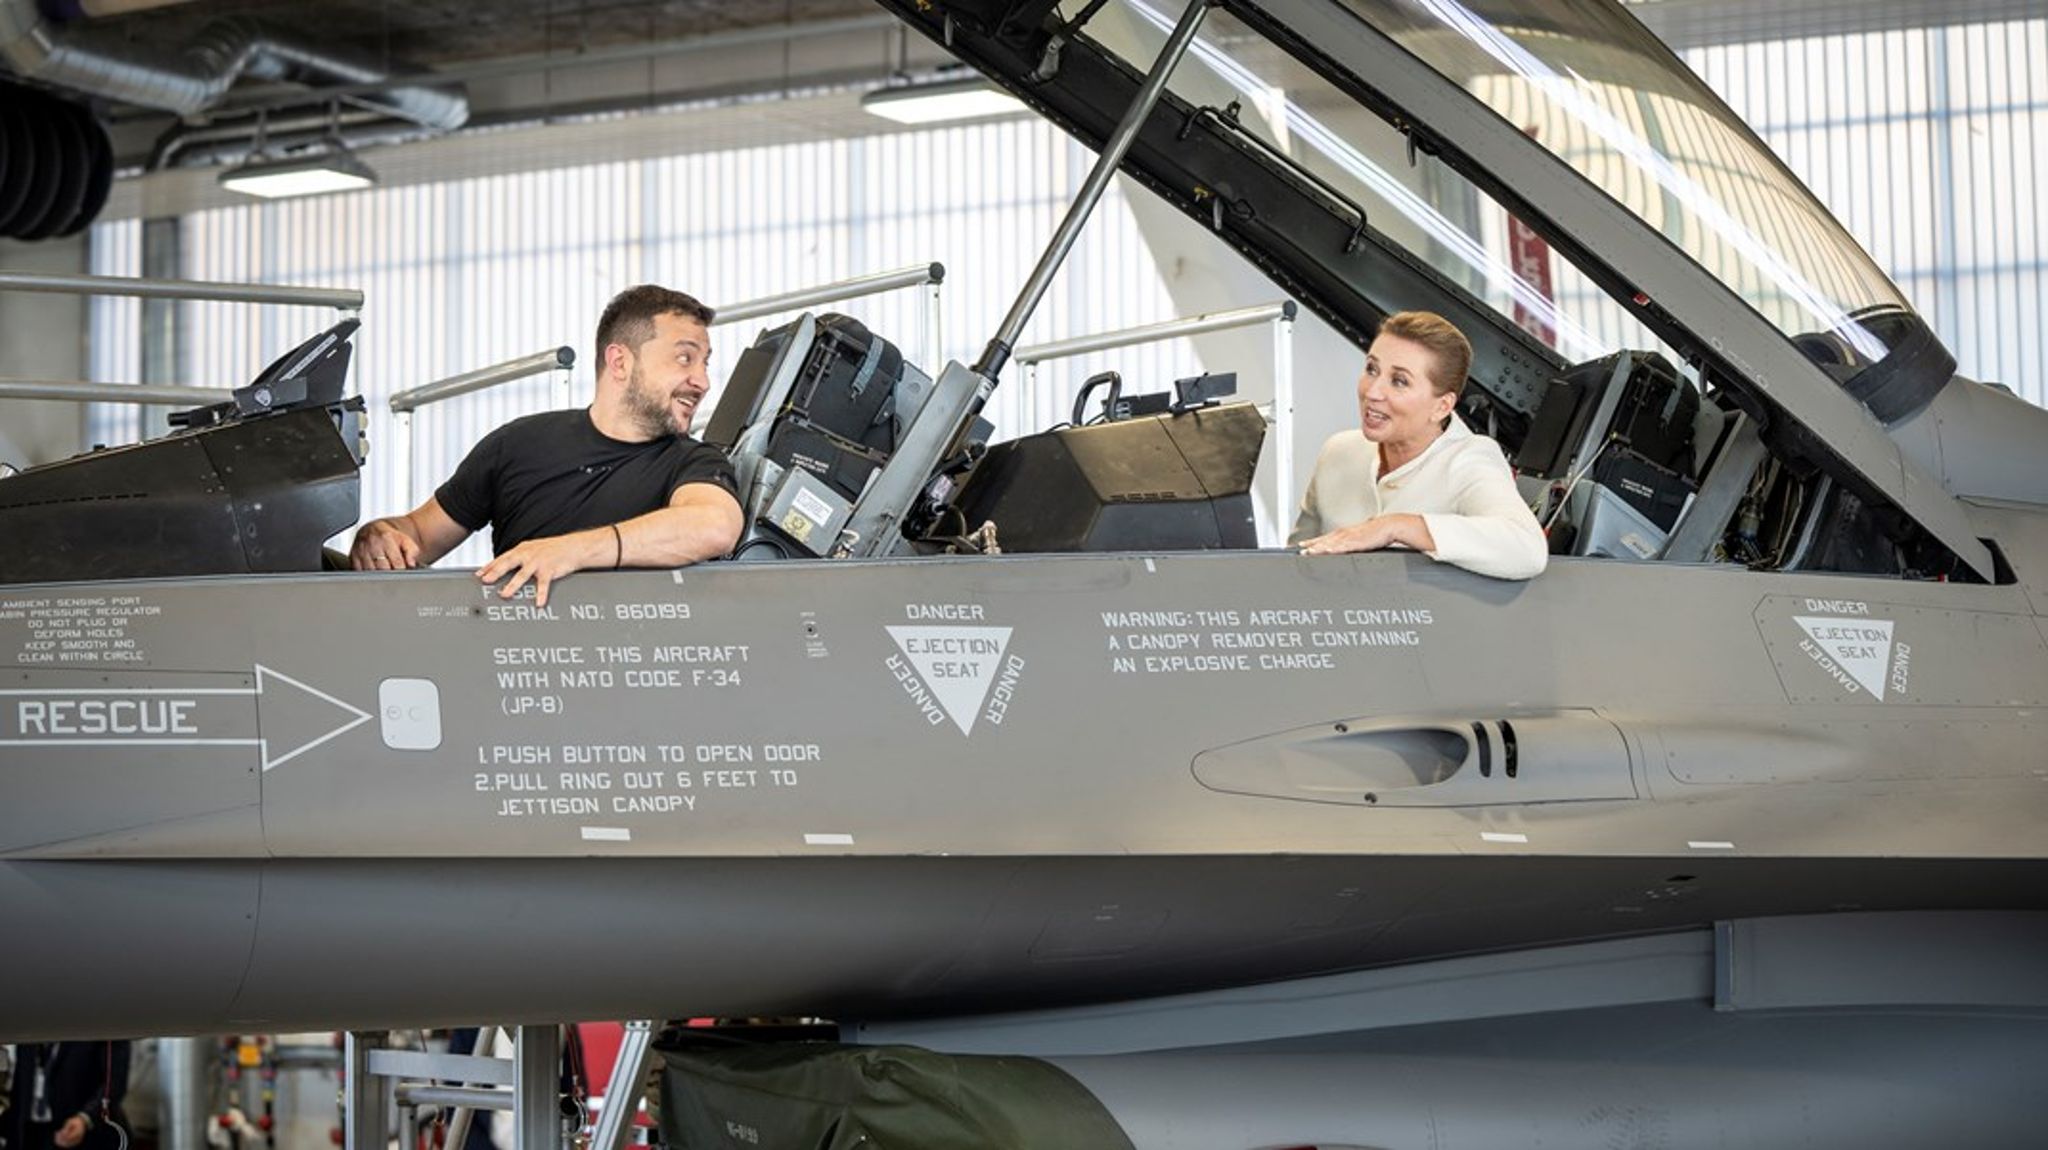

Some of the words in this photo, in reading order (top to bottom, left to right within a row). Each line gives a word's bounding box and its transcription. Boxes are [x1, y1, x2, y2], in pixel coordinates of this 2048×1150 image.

[2, 599, 50, 608] AMBIENT
[113, 596, 140, 605] PORT
[1805, 598, 1869, 615] DANGER
[30, 608, 91, 617] PRESSURE
[96, 606, 161, 616] REGULATOR
[487, 605, 558, 621] SERIAL
[616, 603, 690, 619] 860199
[906, 604, 984, 620] DANGER
[1101, 611, 1193, 627] WARNING:
[1196, 610, 1240, 626] THIS
[1250, 610, 1333, 625] AIRCRAFT
[1344, 609, 1433, 625] CONTAINS
[50, 619, 71, 628] NOT
[77, 618, 106, 627] PLUG
[112, 617, 128, 626] OR
[34, 629, 82, 639] DEFORM
[87, 628, 124, 638] HOLES
[1109, 634, 1121, 651] A
[1127, 633, 1200, 650] CANOPY
[1211, 632, 1303, 648] REMOVER
[1312, 630, 1420, 647] CONTAINING
[1812, 626, 1889, 643] EJECTION
[25, 641, 56, 651] KEEP
[61, 640, 108, 650] SMOOTH
[114, 639, 135, 649] AND
[906, 638, 1000, 655] EJECTION
[1837, 646, 1877, 659] SEAT
[18, 652, 54, 663] CLEAN
[58, 651, 98, 661] WITHIN
[103, 650, 145, 661] CIRCLE
[493, 648, 584, 665] SERVICE
[596, 647, 642, 664] THIS
[653, 646, 750, 663] AIRCRAFT
[1113, 657, 1137, 673] AN
[1145, 655, 1251, 672] EXPLOSIVE
[1259, 653, 1336, 670] CHARGE
[932, 662, 980, 678] SEAT
[1798, 638, 1860, 693] DANGER
[497, 672, 549, 689] WITH
[560, 671, 614, 688] NATO
[625, 670, 682, 687] CODE
[692, 669, 742, 686] F-34
[884, 653, 946, 726] DANGER
[985, 654, 1025, 725] DANGER
[501, 695, 564, 715] (JP-8)
[18, 700, 198, 734] RESCUE
[563, 746, 647, 763] BUTTON
[658, 745, 685, 763] TO
[696, 744, 753, 762] OPEN
[764, 744, 821, 761] DOOR
[560, 772, 612, 789] RING
[623, 772, 665, 789] OUT
[677, 772, 692, 788] 6
[702, 771, 757, 787] FEET
[770, 770, 798, 786] TO
[498, 797, 600, 815] JETTISON
[612, 795, 696, 813] CANOPY
